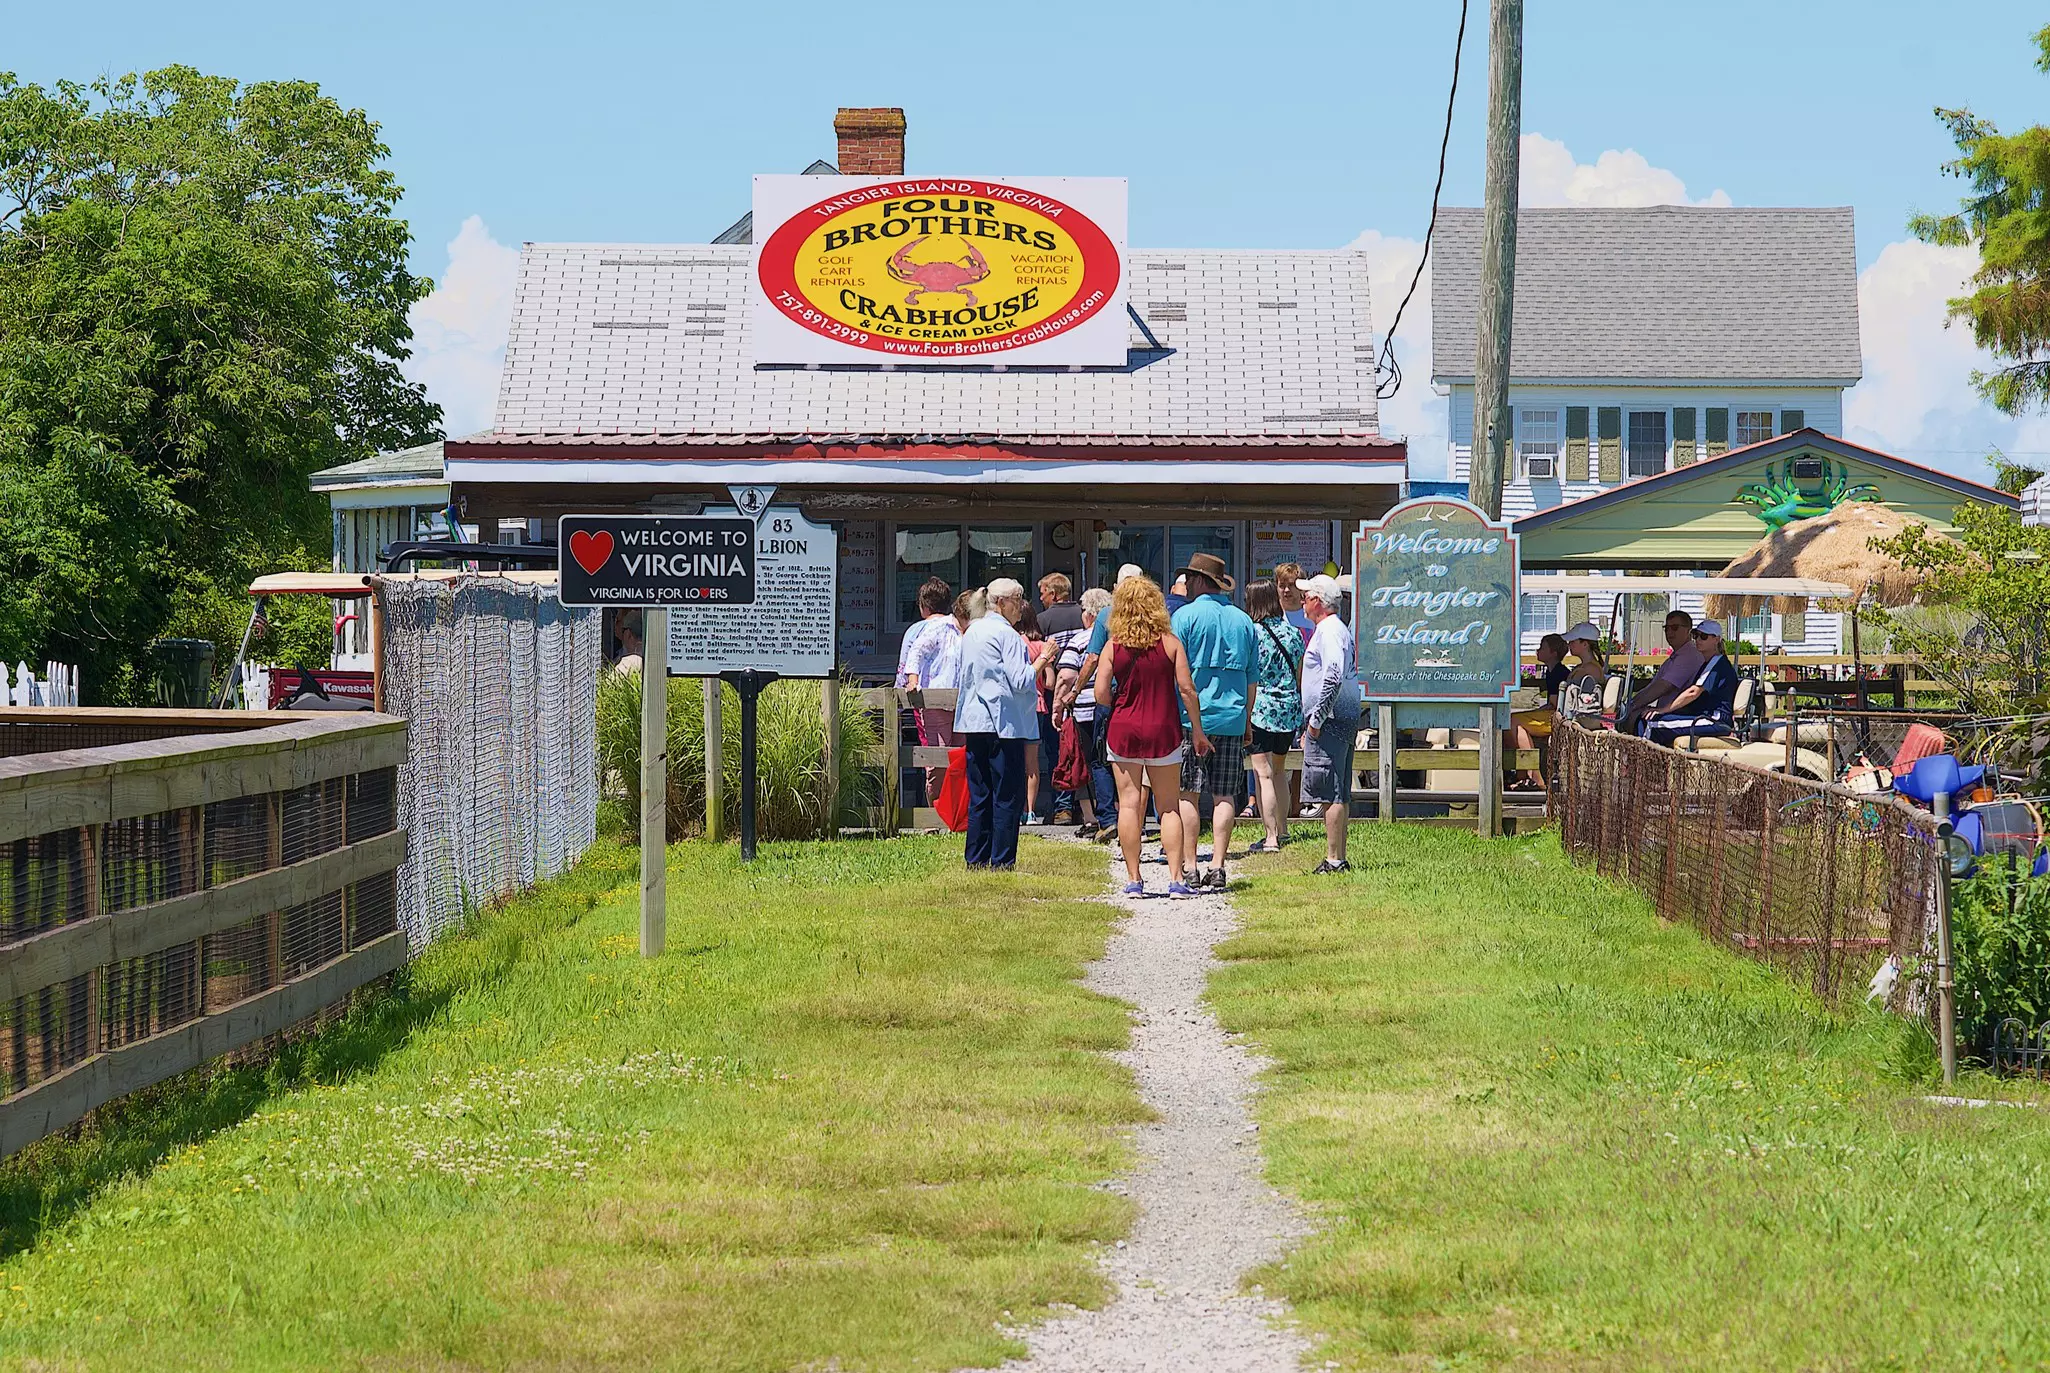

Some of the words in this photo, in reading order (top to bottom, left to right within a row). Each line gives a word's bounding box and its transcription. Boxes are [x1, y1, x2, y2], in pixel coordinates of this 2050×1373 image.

[814, 186, 894, 217] TANGIER
[898, 182, 977, 194] ISLAND,
[986, 186, 1064, 218] VIRGINIA
[884, 199, 996, 218] FOUR
[824, 216, 1057, 252] BROTHERS
[818, 256, 854, 264] GOLF
[1010, 254, 1074, 263] VACATION
[820, 267, 852, 276] CART
[1014, 266, 1070, 274] COTTAGE
[810, 278, 865, 286] RENTALS
[1016, 276, 1067, 284] RENTALS
[840, 286, 1040, 326] CRABHOUSE
[776, 290, 868, 345] 757-891-2999
[884, 289, 1104, 354] www.FourBrothersCrabHouse.com
[860, 320, 871, 328] &
[876, 323, 904, 336] ICE
[908, 329, 966, 338] CREAM
[973, 320, 1017, 336] DECK
[773, 518, 792, 532] 83
[620, 530, 714, 546] WELCOME
[721, 531, 747, 546] TO
[1372, 528, 1500, 555] Welcome
[757, 540, 807, 555] LBION
[620, 554, 746, 577] VIRGINIA
[1425, 562, 1448, 577] to
[590, 588, 643, 598] VIRGINIA
[646, 588, 654, 598] IS
[658, 588, 682, 598] FOR
[1371, 580, 1499, 617] Tangier
[1408, 671, 1416, 680] of
[1418, 671, 1430, 680] the
[1434, 670, 1478, 682] Chesapeake
[322, 682, 374, 694] Kawasak
